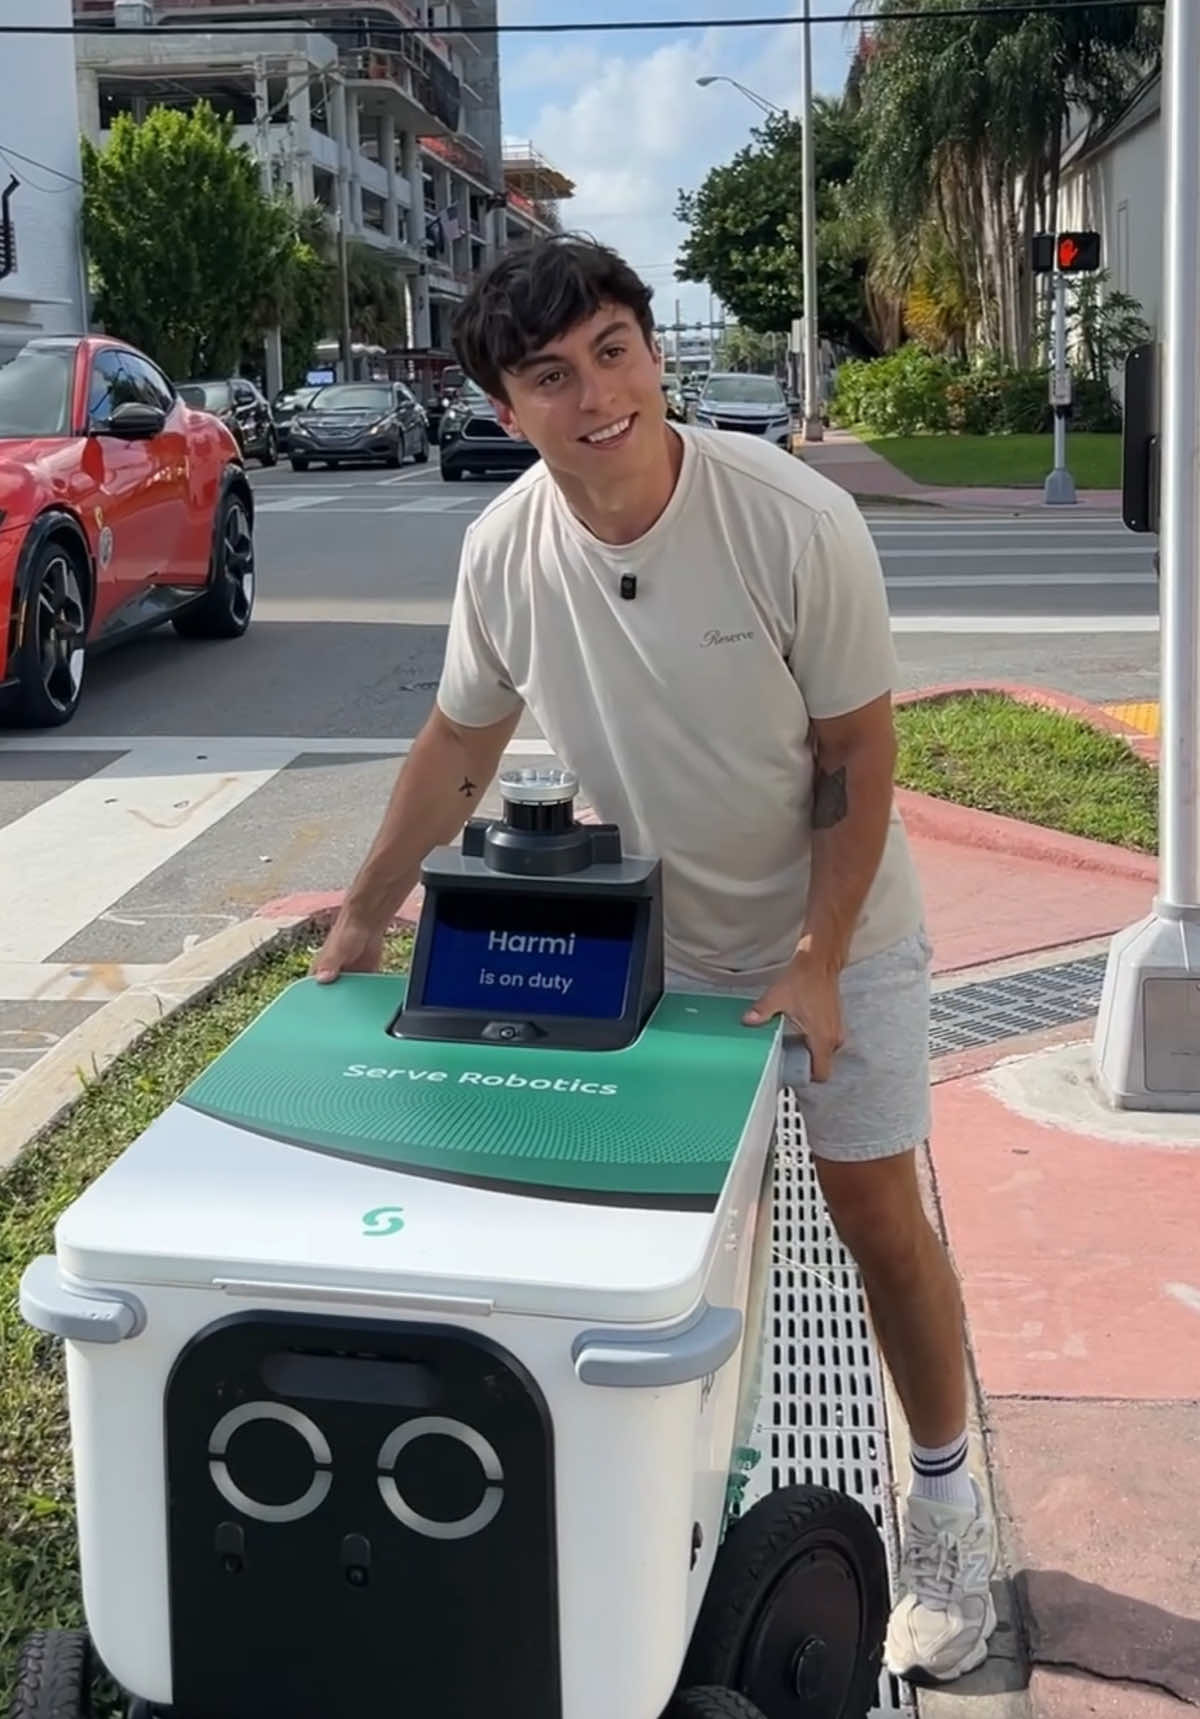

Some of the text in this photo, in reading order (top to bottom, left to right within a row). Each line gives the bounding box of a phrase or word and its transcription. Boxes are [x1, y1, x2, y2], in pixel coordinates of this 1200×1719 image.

[699, 629, 755, 648] Reserve
[488, 930, 576, 955] Harmi
[480, 968, 573, 994] is on duty
[343, 1064, 618, 1095] Serve Robotics
